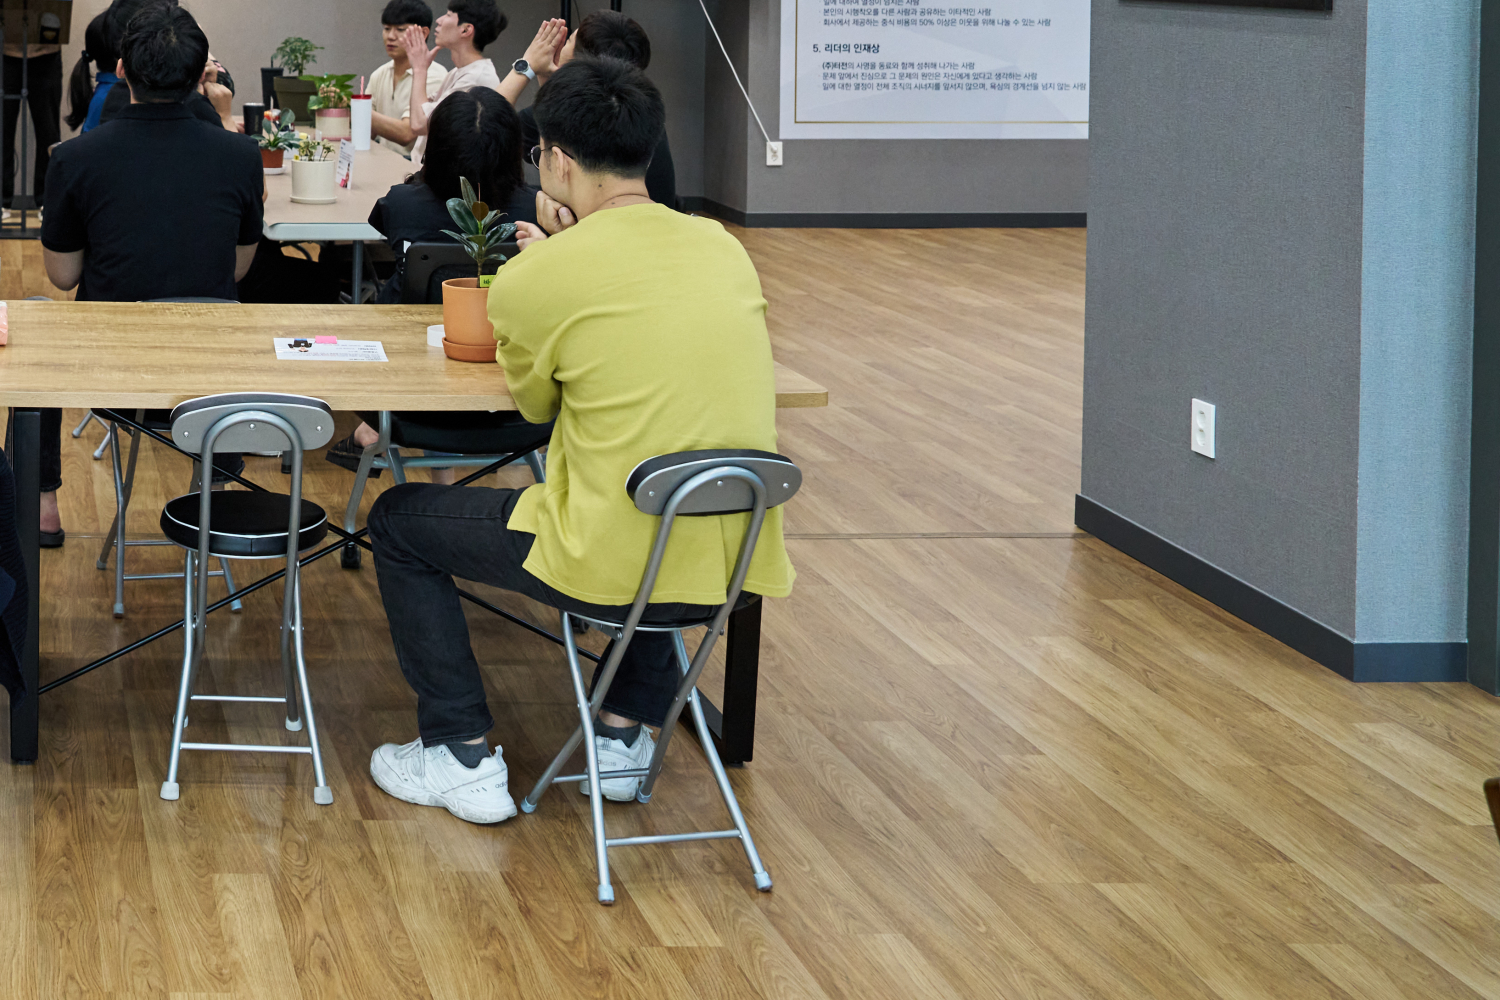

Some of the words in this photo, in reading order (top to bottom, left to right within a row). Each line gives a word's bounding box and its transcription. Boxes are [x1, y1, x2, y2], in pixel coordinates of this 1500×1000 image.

[812, 44, 821, 52] 5.
[824, 44, 851, 53] 리더의
[853, 44, 880, 53] 인재상
[597, 759, 616, 767] didas
[495, 780, 508, 789] adi
